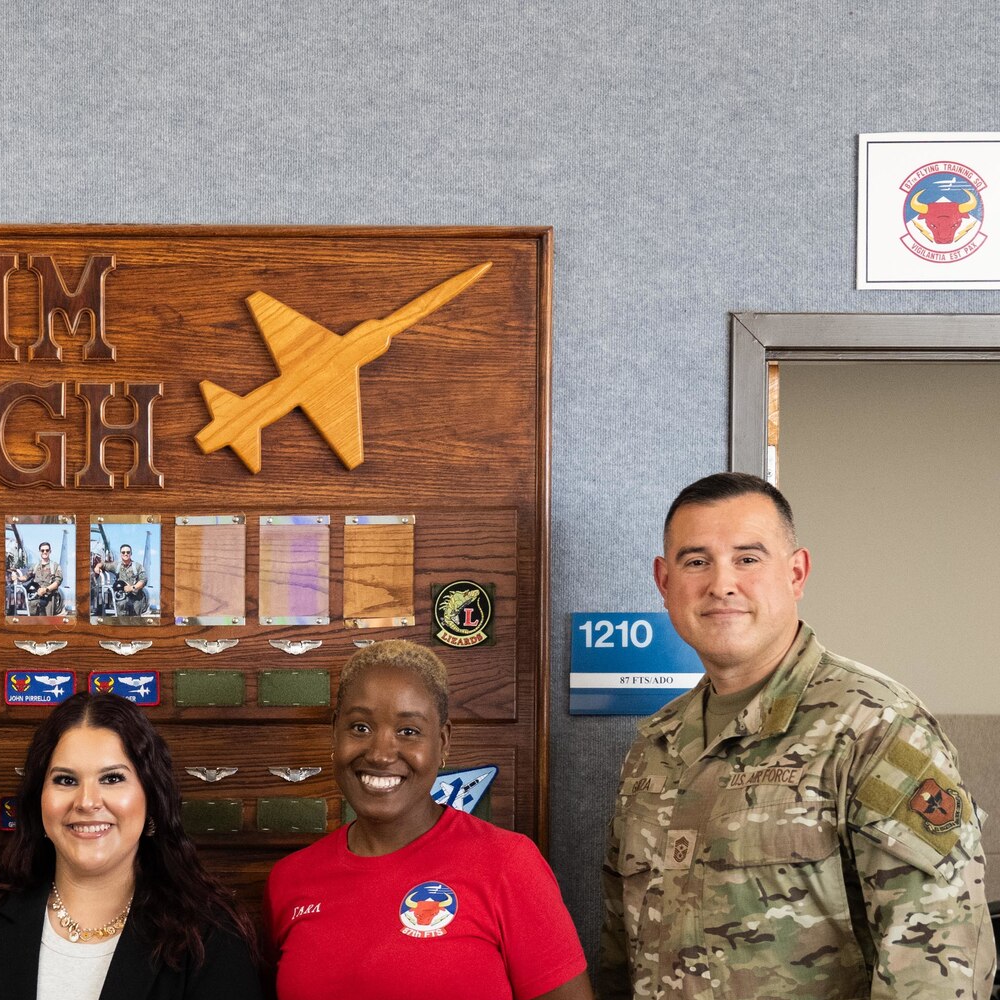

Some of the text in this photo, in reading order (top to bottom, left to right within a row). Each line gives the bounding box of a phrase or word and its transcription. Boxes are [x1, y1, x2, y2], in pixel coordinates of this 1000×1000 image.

[916, 164, 940, 180] FLYING
[943, 164, 974, 180] TRAINING
[972, 178, 983, 188] SQ
[911, 242, 978, 261] VIGILANTIA EST PAX
[441, 632, 484, 646] LIZARDS
[578, 619, 654, 649] 1210
[620, 676, 674, 684] 87 FTS/ADO
[8, 694, 24, 702] JOHN
[762, 768, 798, 784] FORCE
[402, 927, 444, 938] 87th FTS
